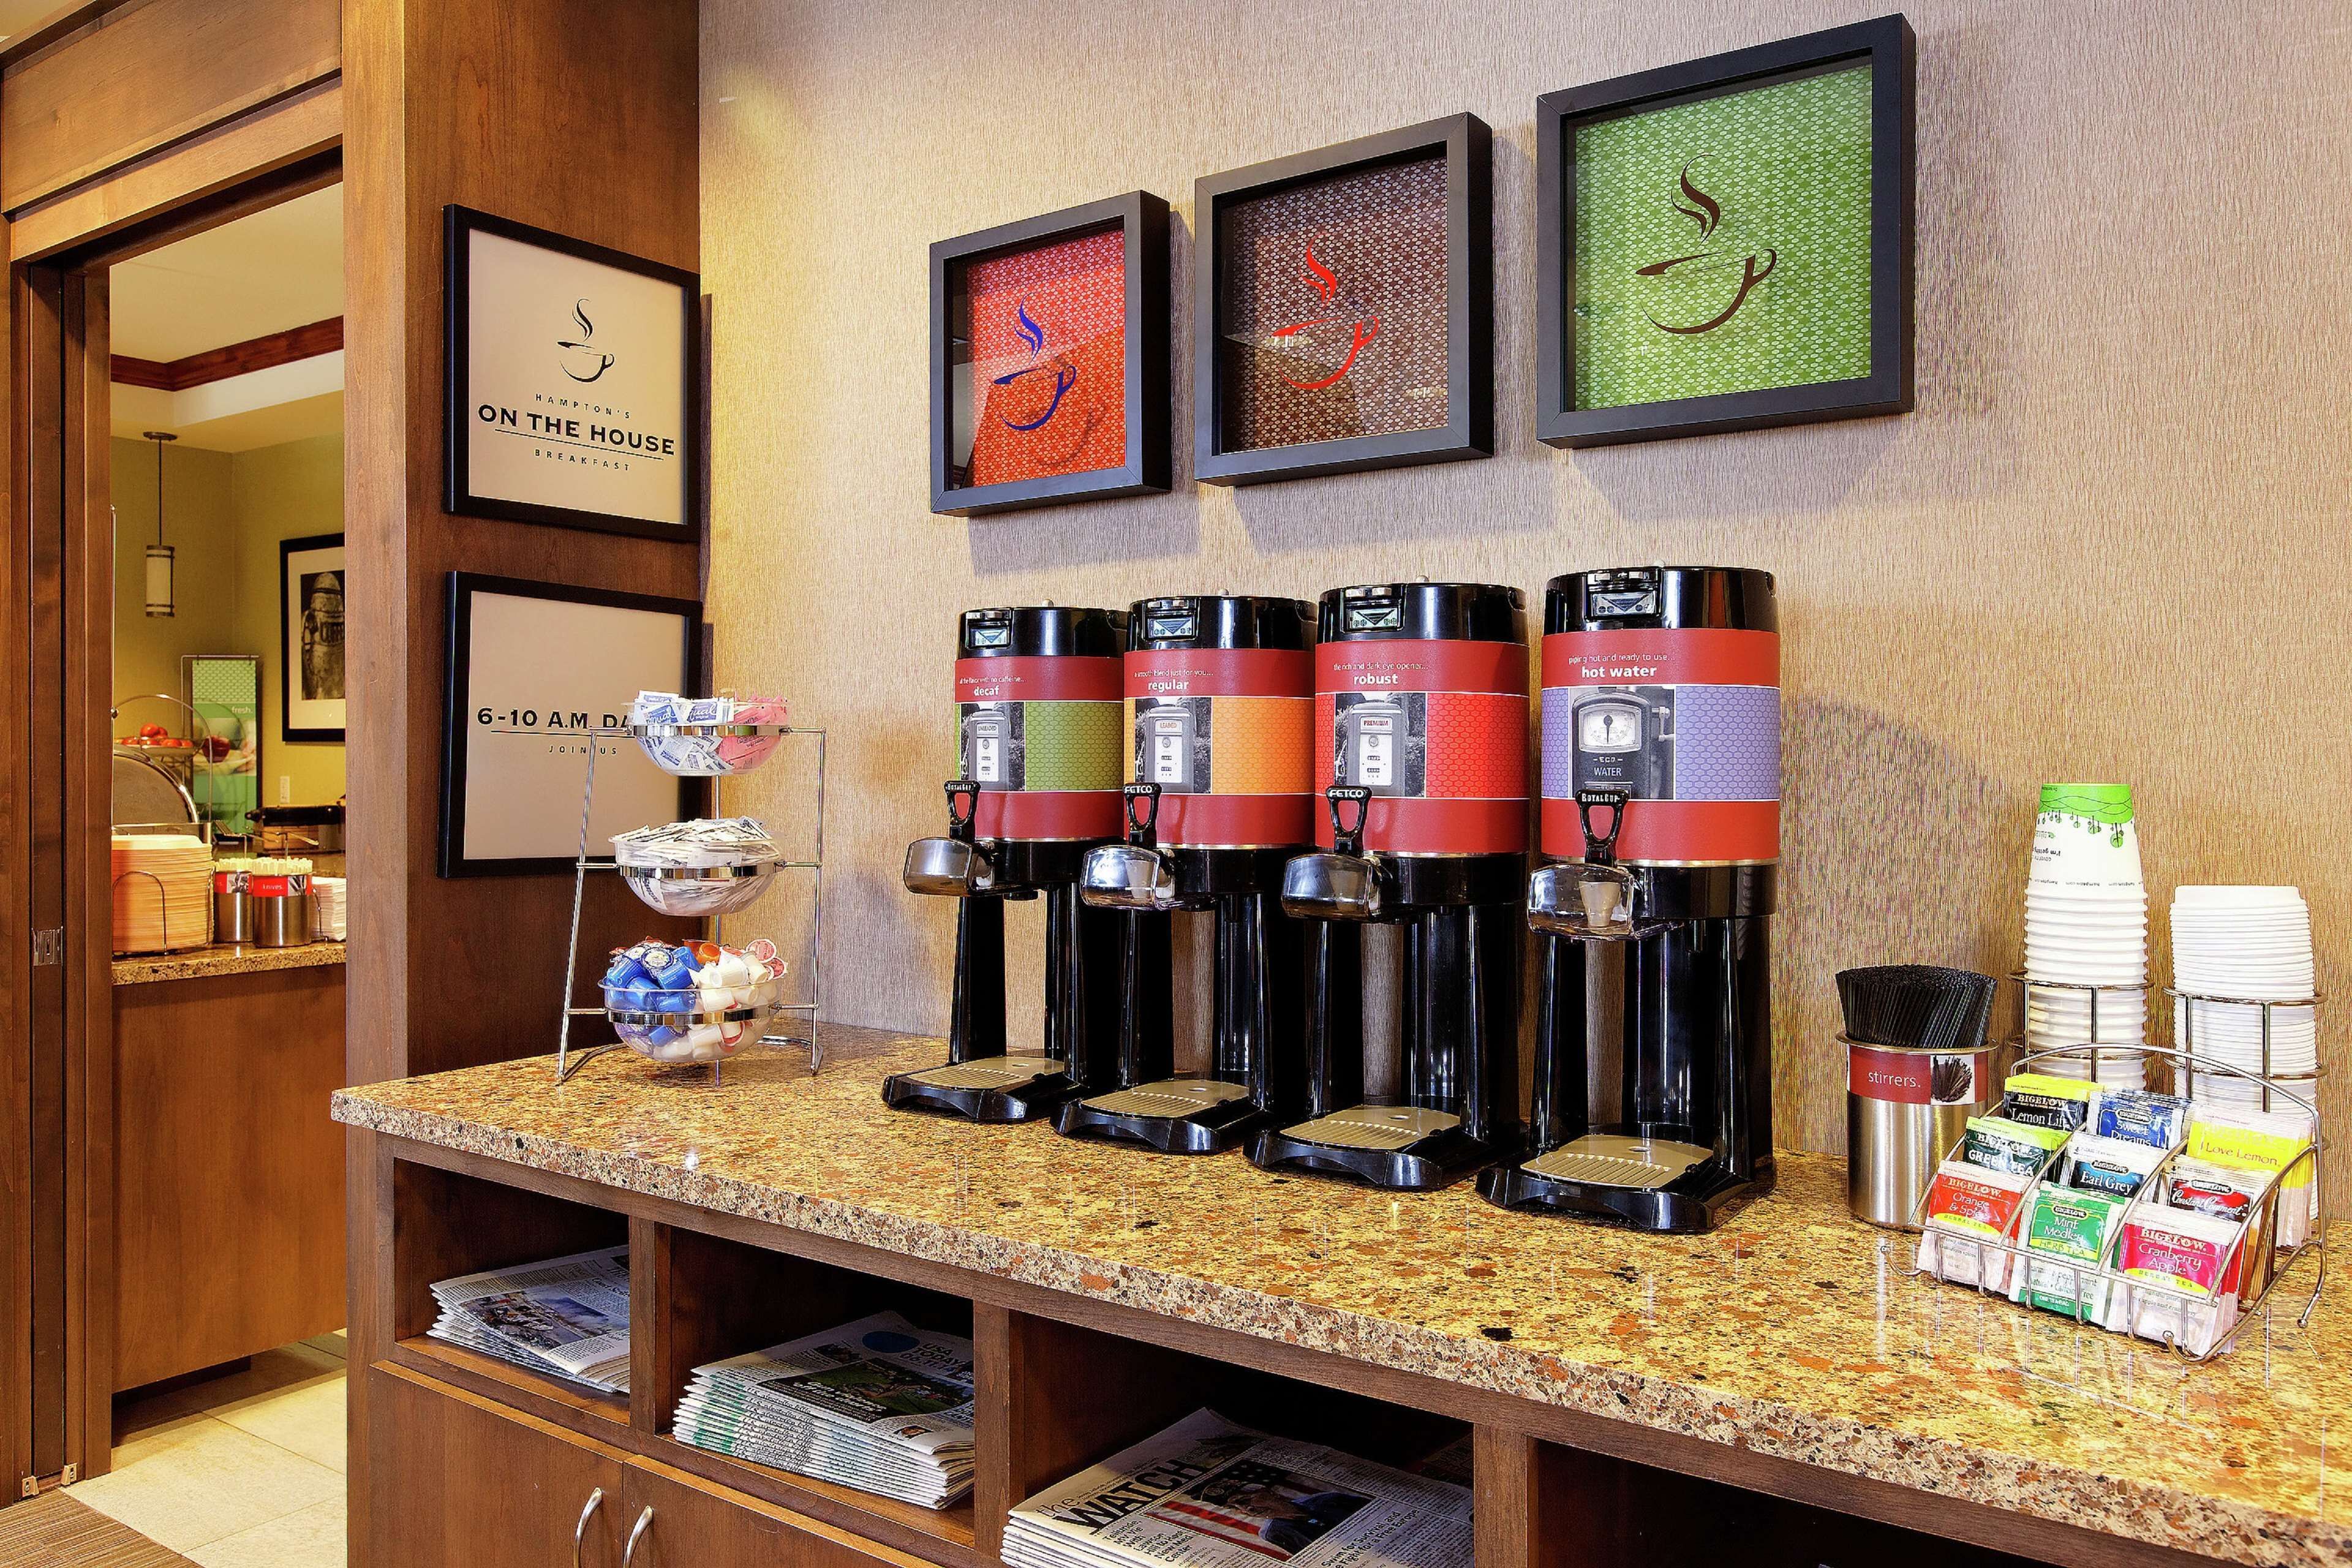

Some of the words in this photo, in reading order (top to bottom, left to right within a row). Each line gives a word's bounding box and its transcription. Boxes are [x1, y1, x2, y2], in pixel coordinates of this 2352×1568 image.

[535, 393, 630, 419] HAMPTON'S
[478, 404, 517, 427] ON
[527, 412, 580, 439] THE
[590, 424, 674, 456] HOUSE
[535, 449, 629, 471] BREAKFAST
[1602, 654, 1617, 662] and
[1619, 653, 1640, 663] ready
[1354, 673, 1398, 685] robust
[1581, 666, 1605, 678] hot
[1610, 665, 1657, 677] water
[974, 685, 1000, 696] decaf
[1148, 679, 1189, 693] regular
[477, 707, 538, 727] 6-10
[547, 710, 593, 729] A.M.
[549, 745, 586, 754] JOIN
[1594, 767, 1623, 776] WATER
[1124, 785, 1153, 794] FETCO
[1329, 789, 1364, 798] FETCO
[1868, 1070, 1921, 1088] stirrers.
[2018, 1093, 2068, 1108] BIGELOW
[2115, 1120, 2149, 1136] Sweet
[2111, 1129, 2152, 1147] Dreams
[1969, 1149, 2008, 1169] GREEN
[2206, 1142, 2233, 1156] Love
[2236, 1148, 2278, 1166] Lemon
[2080, 1170, 2103, 1187] Earl
[2105, 1175, 2133, 1196] Grey
[1949, 1202, 1959, 1212] &
[1953, 1192, 1990, 1211] Orange
[2054, 1216, 2079, 1230] Mint
[2040, 1240, 2065, 1251] HERB
[2140, 1227, 2207, 1252] BIGELOW
[2138, 1243, 2202, 1272] Cranberry
[2148, 1257, 2187, 1275] Apple
[2176, 1279, 2193, 1287] TEA
[1052, 1458, 1205, 1536] WATCH
[1036, 1496, 1080, 1520] the
[1376, 1525, 1396, 1542] Free
[1393, 1507, 1420, 1531] Europe
[1123, 1534, 1146, 1548] With
[1134, 1532, 1167, 1552] Lawson
[1154, 1545, 1175, 1559] New
[1174, 1534, 1194, 1547] Med
[1321, 1549, 1346, 1568] Swim
[1343, 1540, 1356, 1553] for
[1384, 1510, 1402, 1525] and
[1144, 1544, 1158, 1556] Hill
[1165, 1544, 1193, 1563] Center
